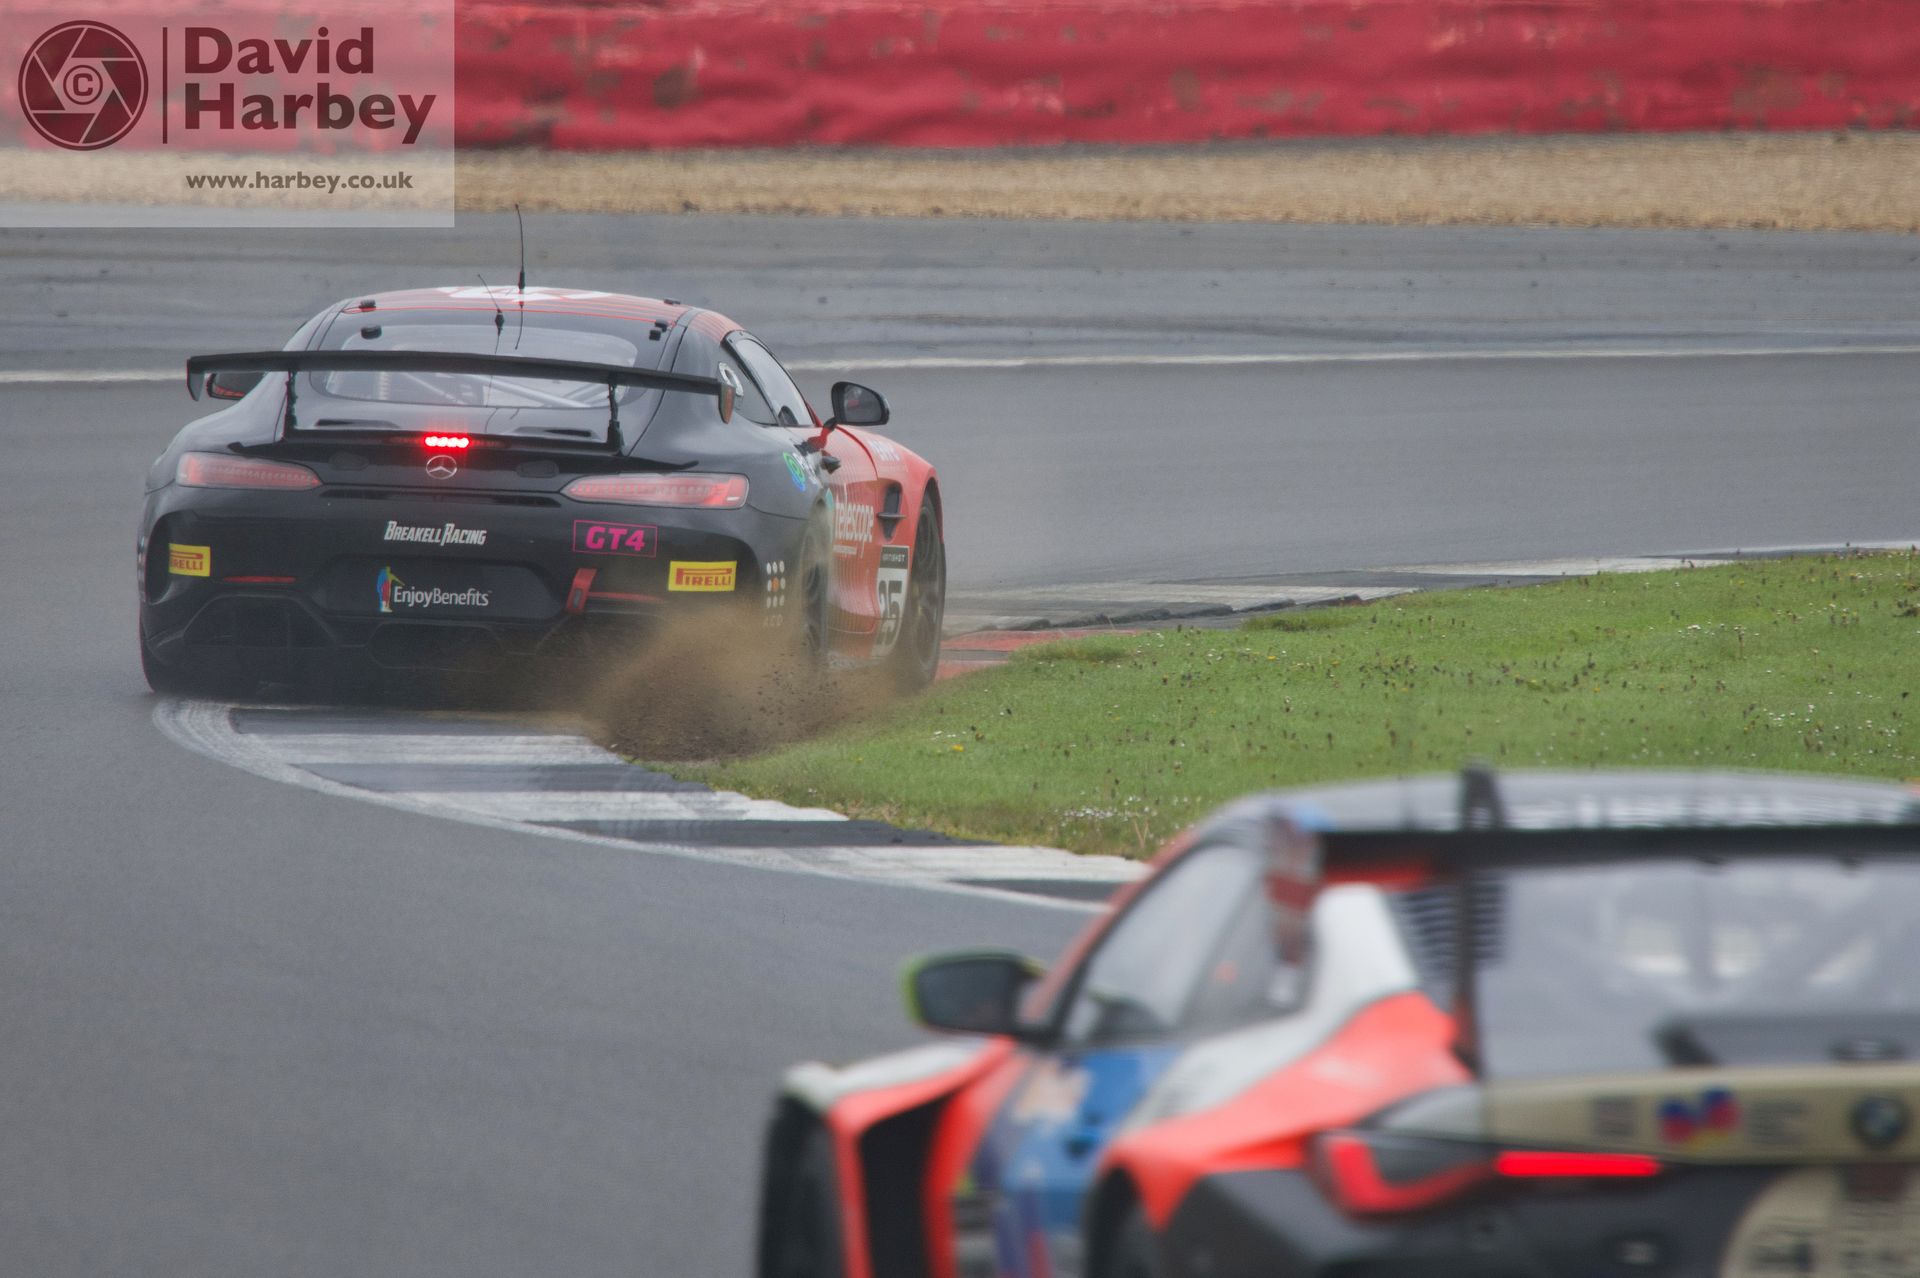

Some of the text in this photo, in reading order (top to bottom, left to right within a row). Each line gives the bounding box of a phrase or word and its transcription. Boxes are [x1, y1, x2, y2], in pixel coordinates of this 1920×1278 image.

[384, 520, 487, 546] BREAKELL RACING
[585, 526, 645, 552] GT4
[672, 567, 733, 586] PIRELLI
